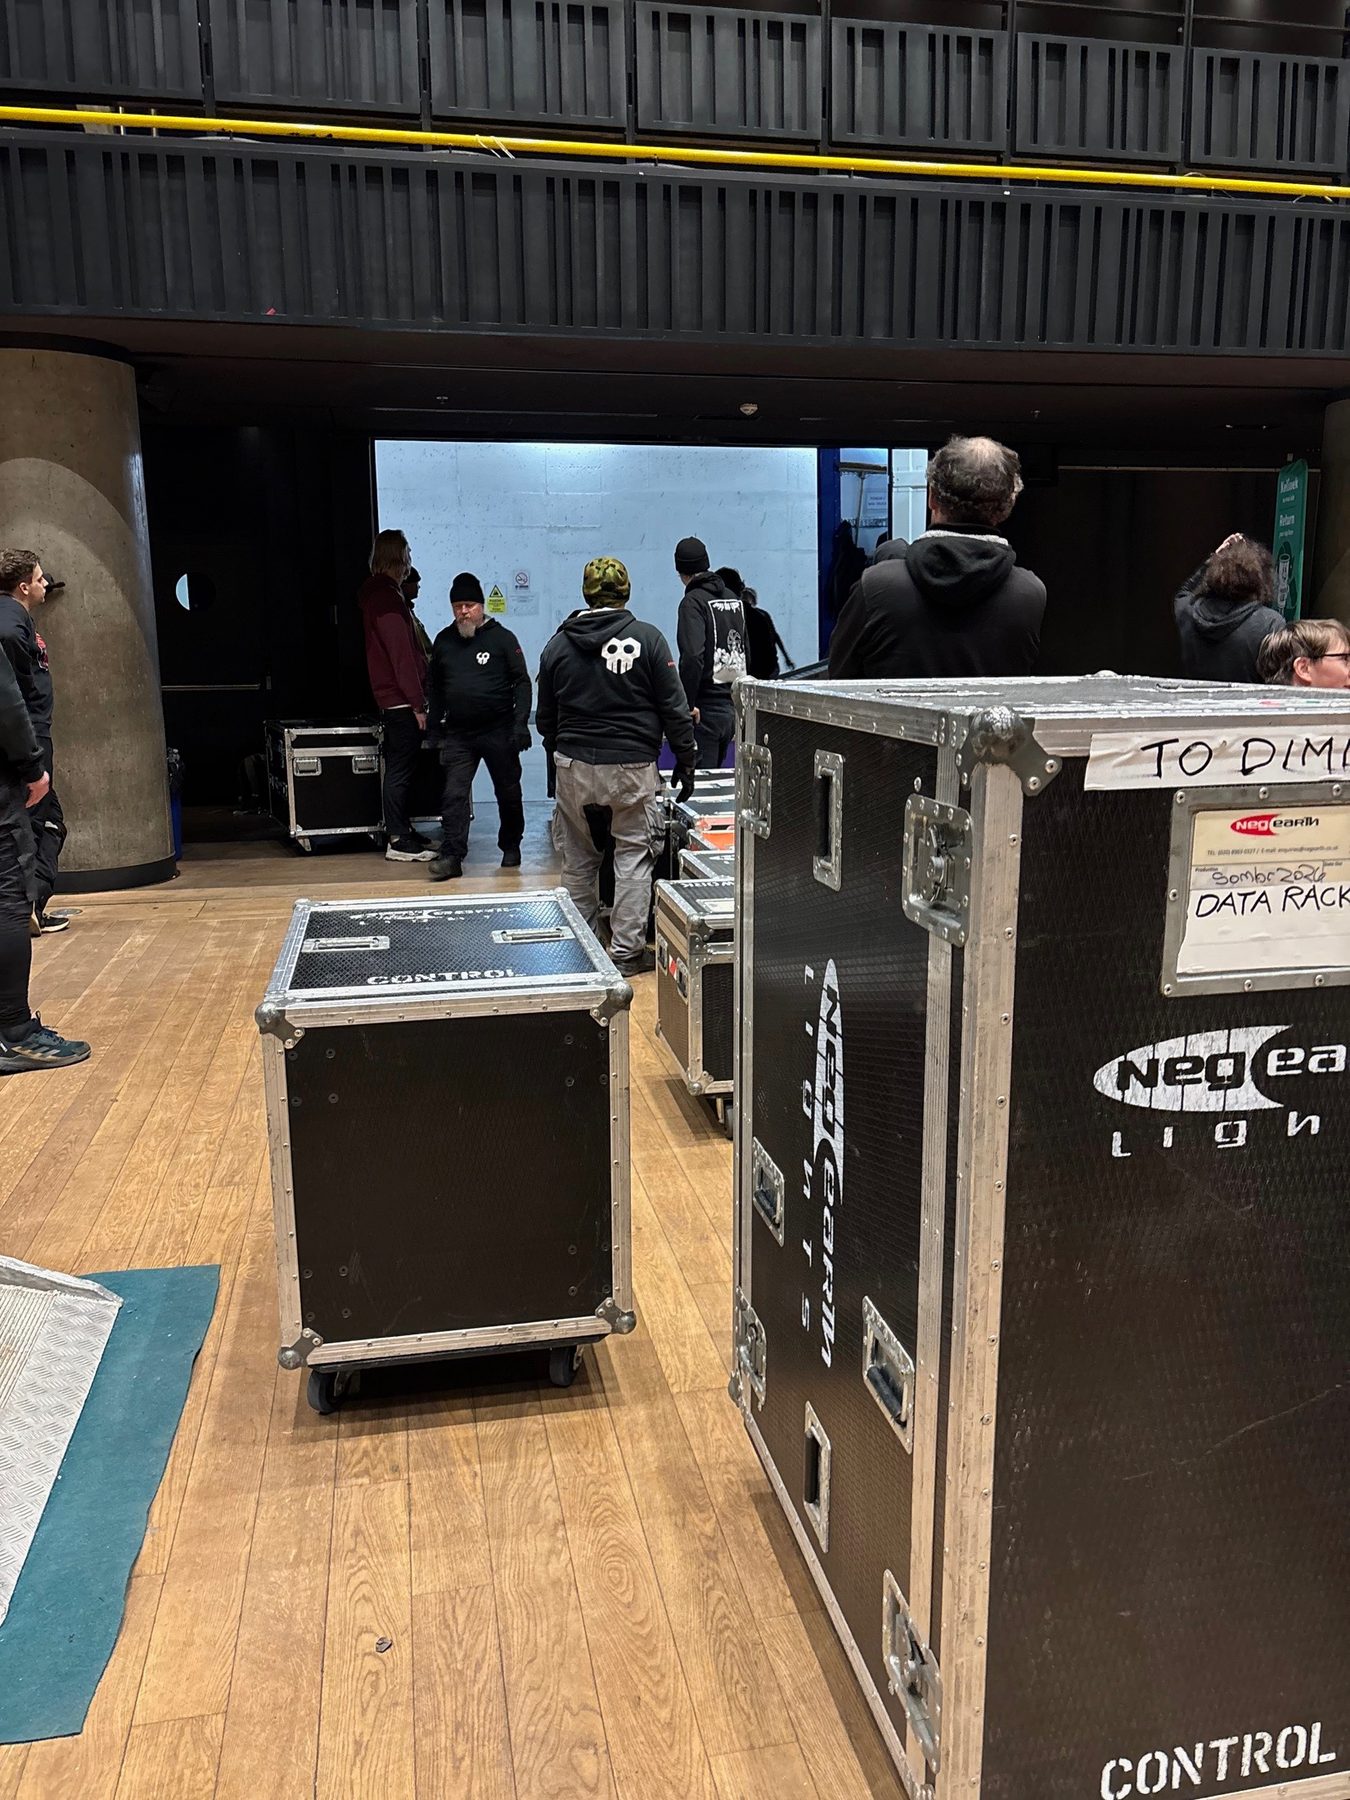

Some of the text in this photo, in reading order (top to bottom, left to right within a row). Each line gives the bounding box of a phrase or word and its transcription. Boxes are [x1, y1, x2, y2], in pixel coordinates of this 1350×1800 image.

[1141, 738, 1213, 779] TO
[1276, 864, 1327, 884] 2026
[1195, 885, 1350, 918] DATA RACK
[367, 968, 526, 985] CONTROL
[1100, 1722, 1337, 1800] CONTROL
